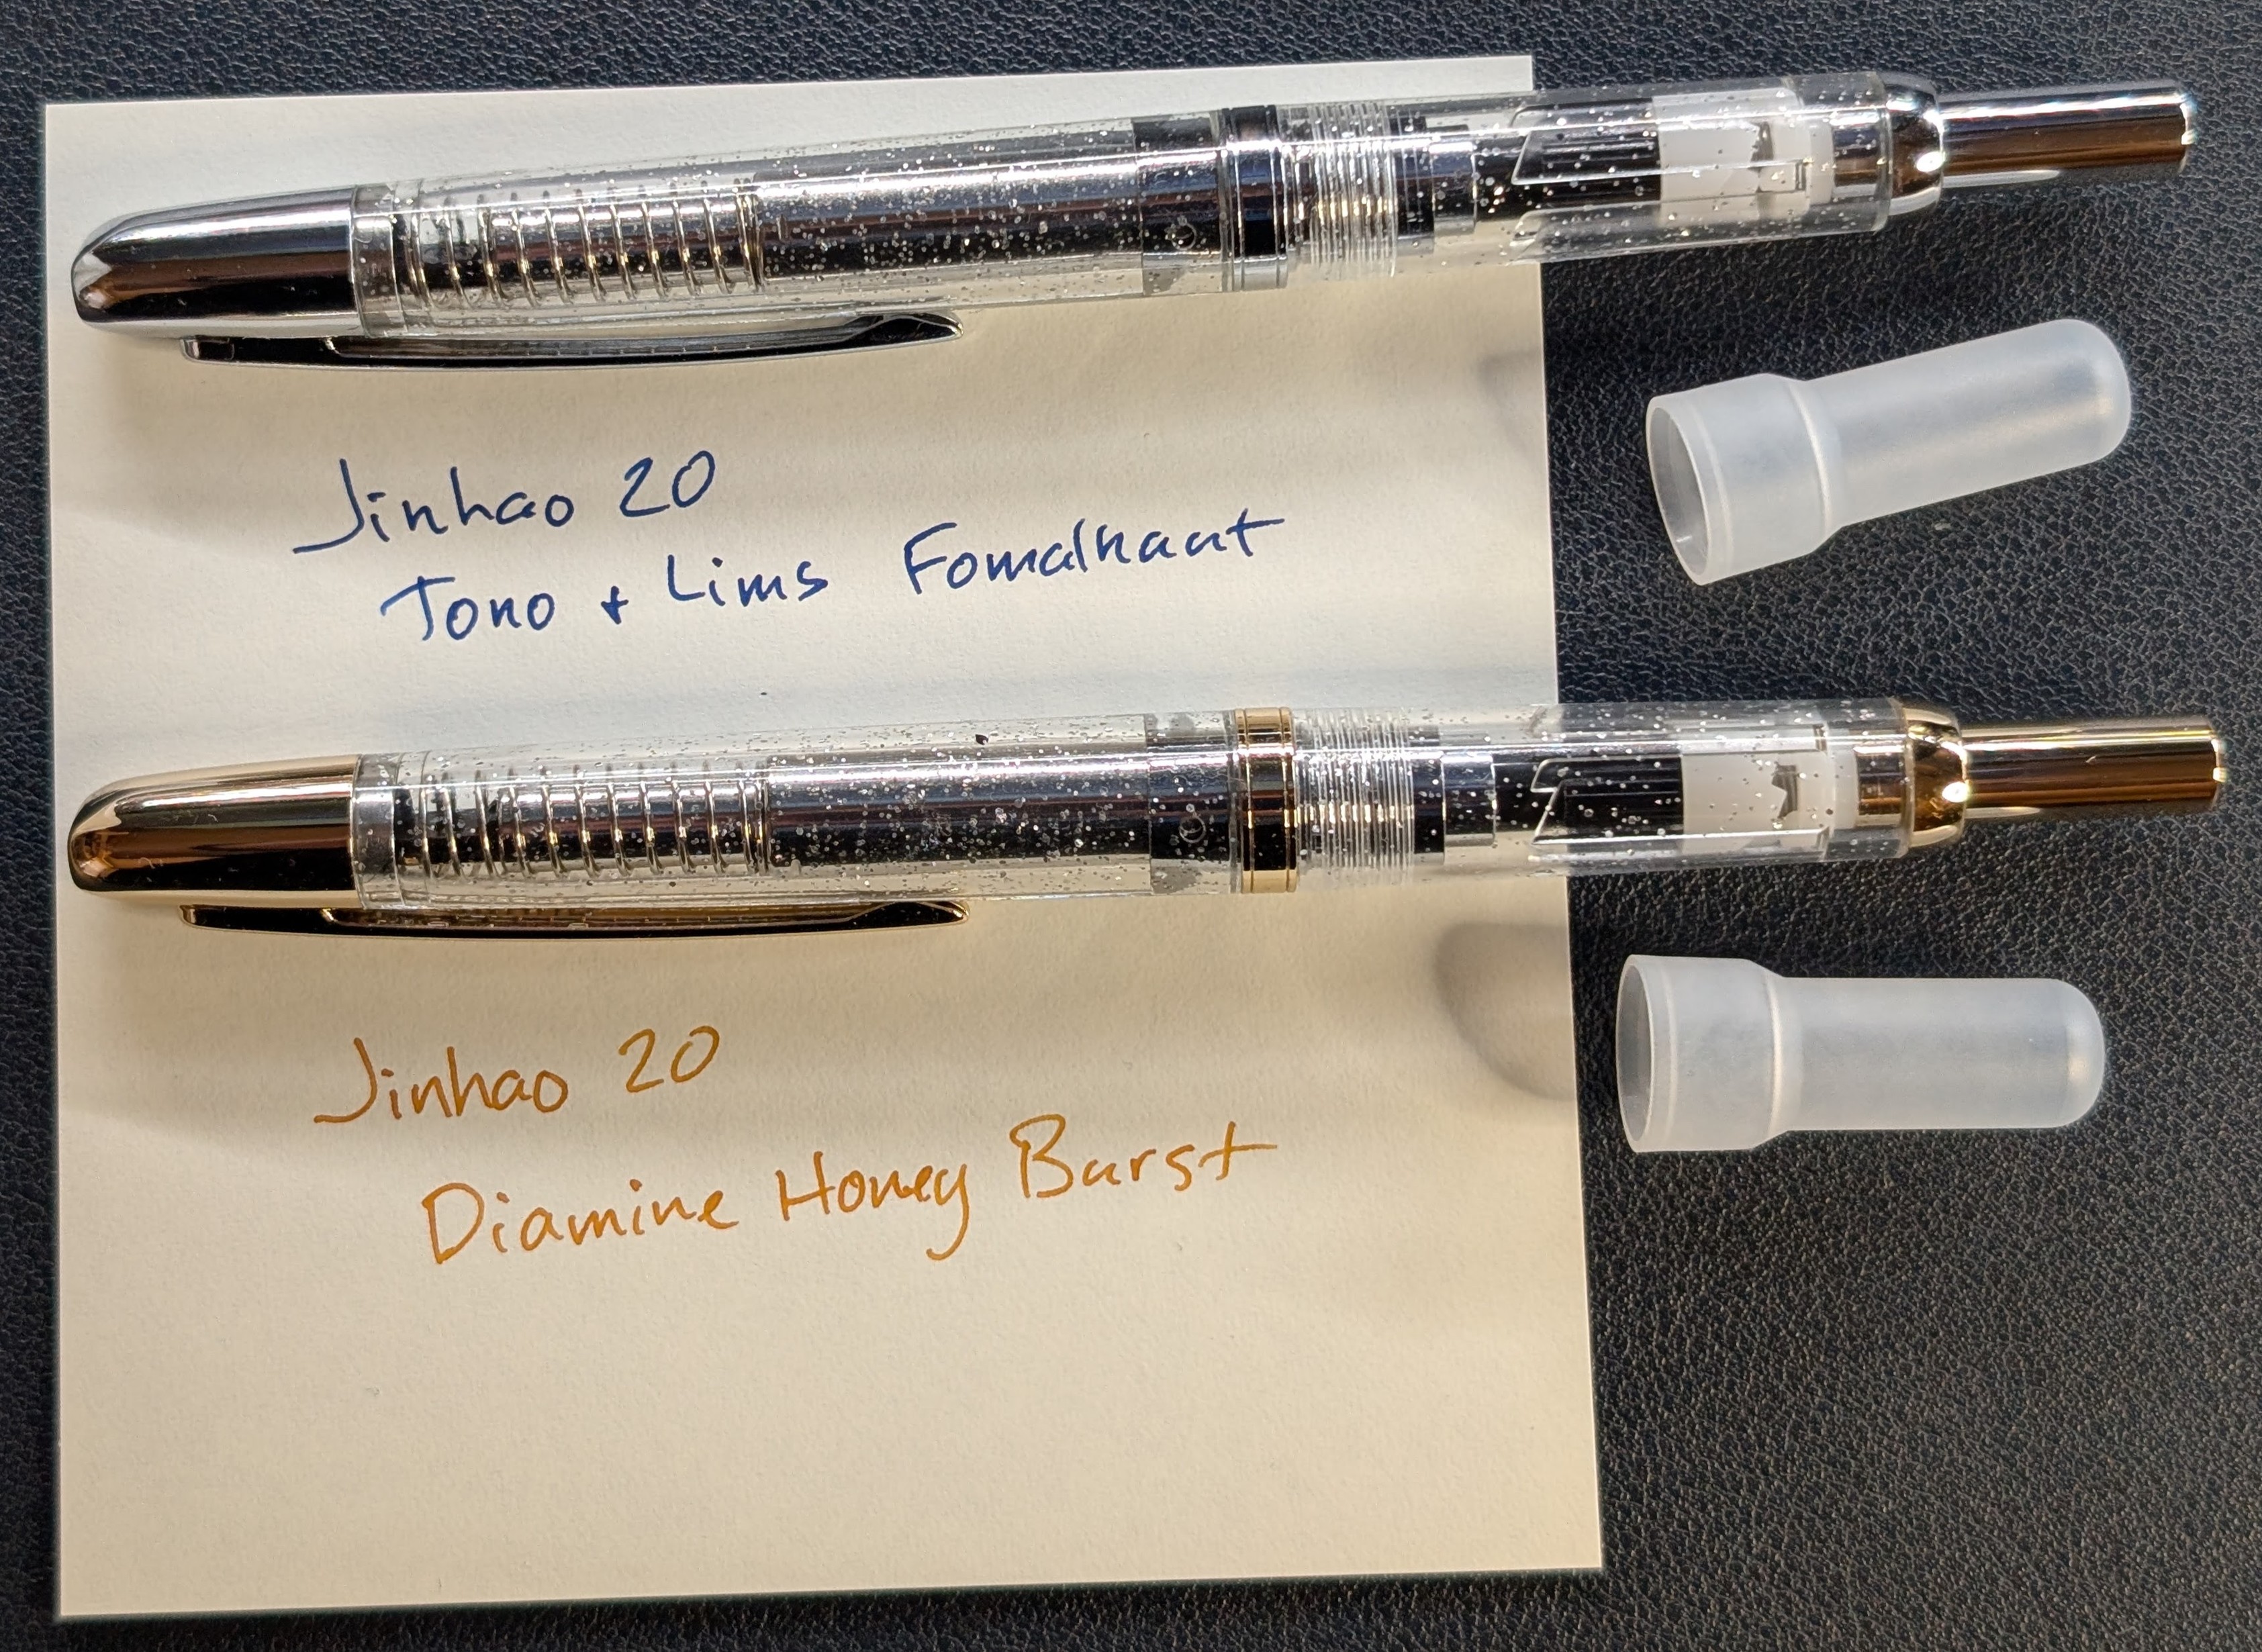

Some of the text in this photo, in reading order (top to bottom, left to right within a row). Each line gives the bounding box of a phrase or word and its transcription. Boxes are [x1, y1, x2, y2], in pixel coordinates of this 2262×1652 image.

[293, 450, 717, 553] Jinhao 20
[379, 575, 556, 641] Tono
[600, 585, 628, 625] +
[665, 554, 829, 607] Lims
[314, 1024, 720, 1124] Jinhao 20
[421, 1112, 1278, 1265] Diamine Honey Burst
